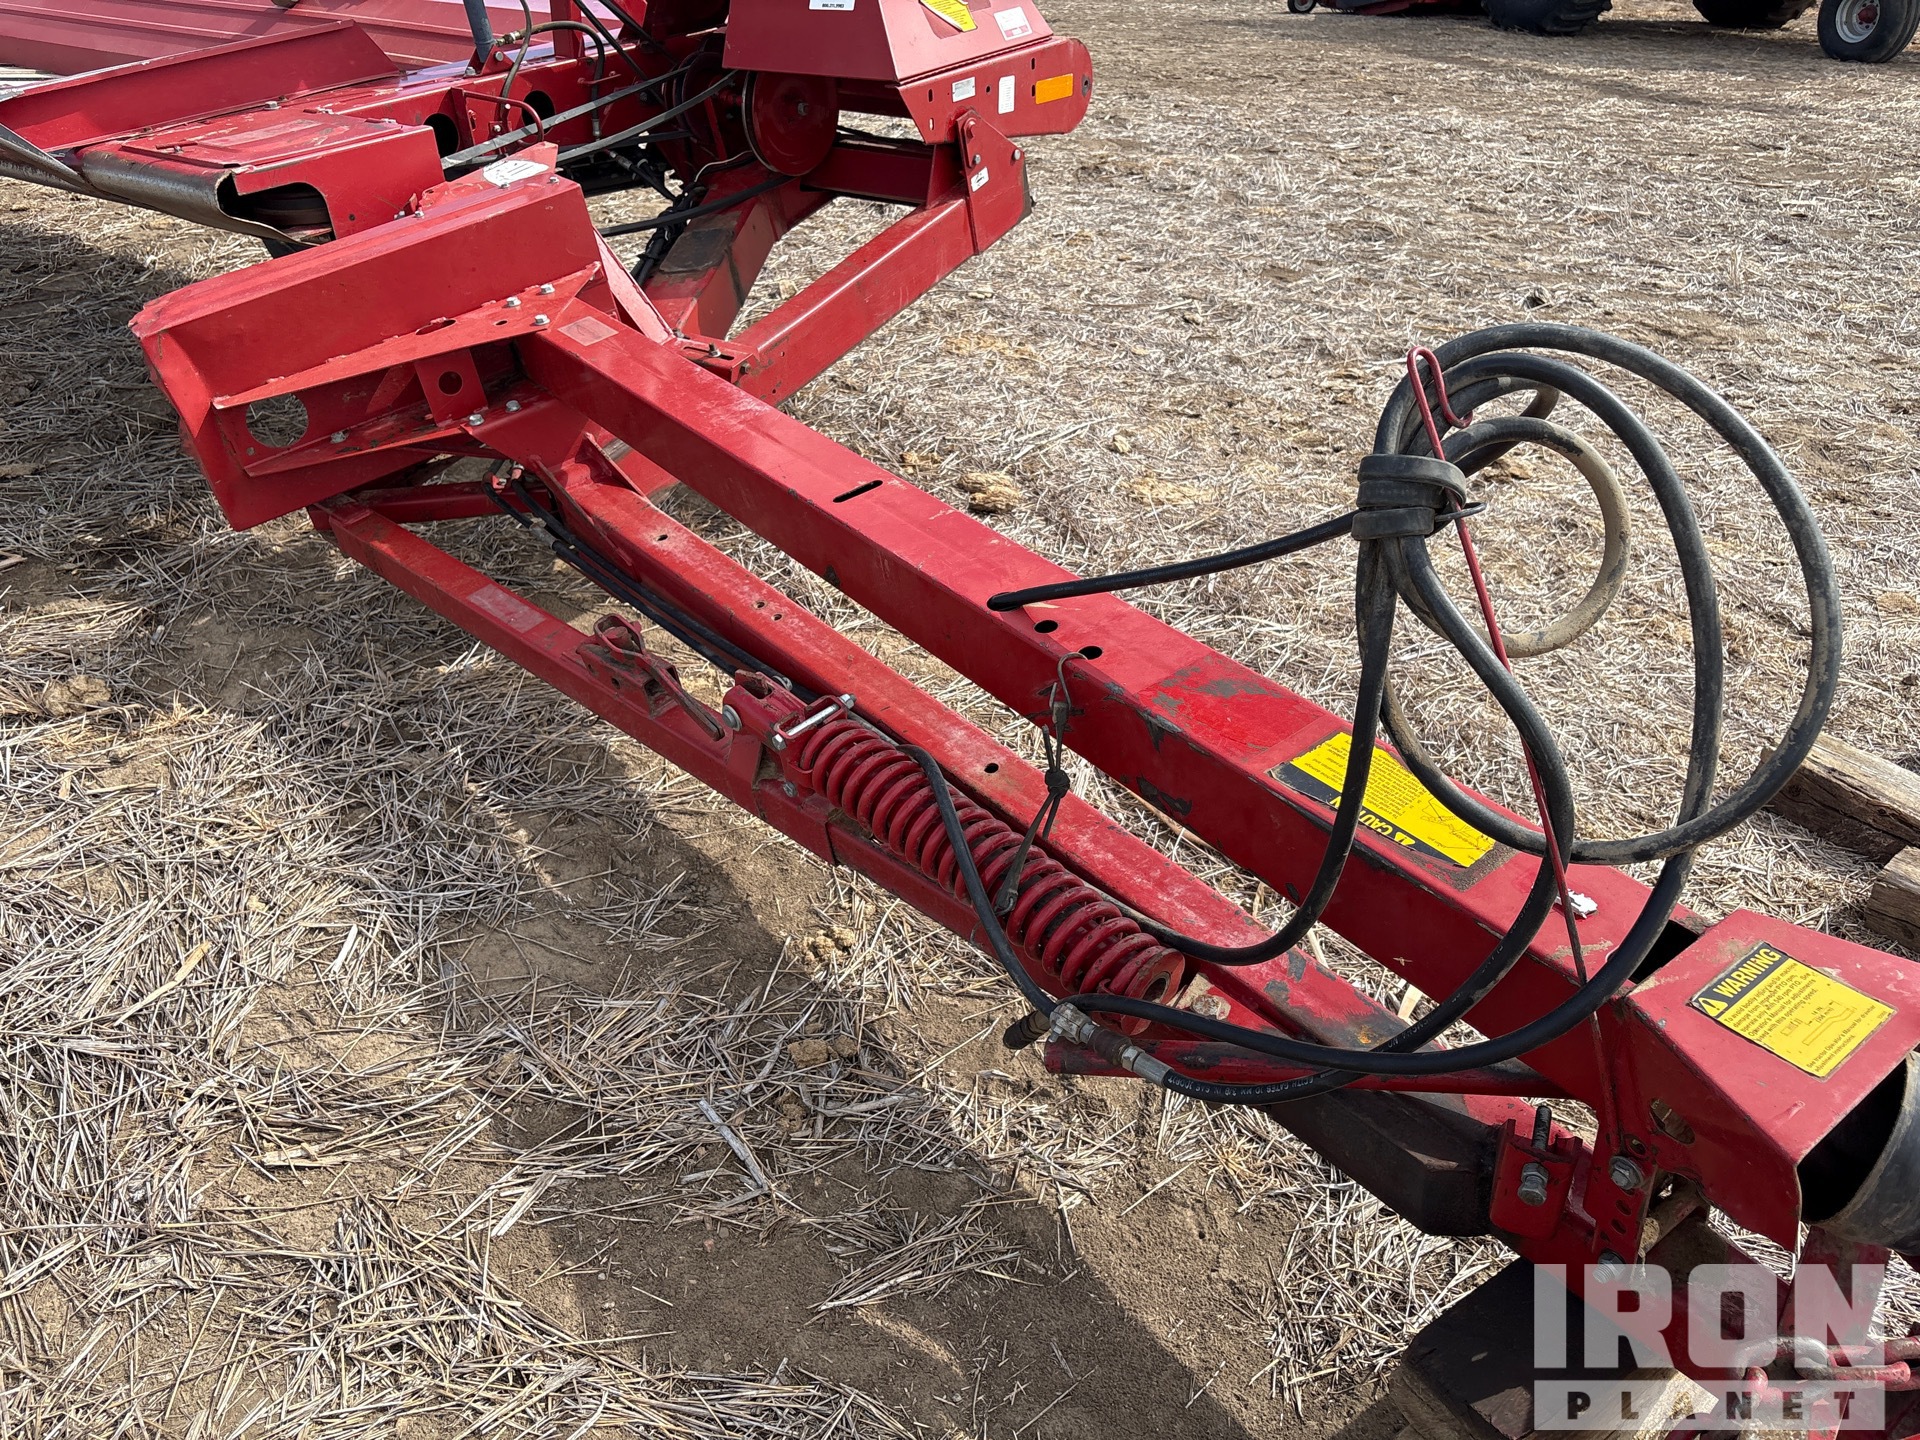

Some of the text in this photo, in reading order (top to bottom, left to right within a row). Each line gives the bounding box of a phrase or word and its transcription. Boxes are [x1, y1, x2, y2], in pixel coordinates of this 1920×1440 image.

[1713, 948, 1781, 998] WARNING
[1730, 1007, 1744, 1018] avoid
[1741, 996, 1757, 1008] bodily
[1778, 962, 1797, 976] machine
[1732, 1013, 1751, 1027] damage
[1748, 1004, 1761, 1013] from
[1775, 981, 1788, 990] PTO
[1755, 1010, 1768, 1018] only
[1781, 988, 1793, 996] rpm
[1800, 972, 1811, 980] See
[1766, 1022, 1778, 1031] with
[1775, 1015, 1786, 1024] this
[1783, 999, 1805, 1016] operating
[1768, 1004, 1786, 1018] Manual
[1789, 979, 1816, 1000] adjustments
[1224, 1088, 1237, 1096] 3/8
[1266, 1084, 1289, 1094] GATES
